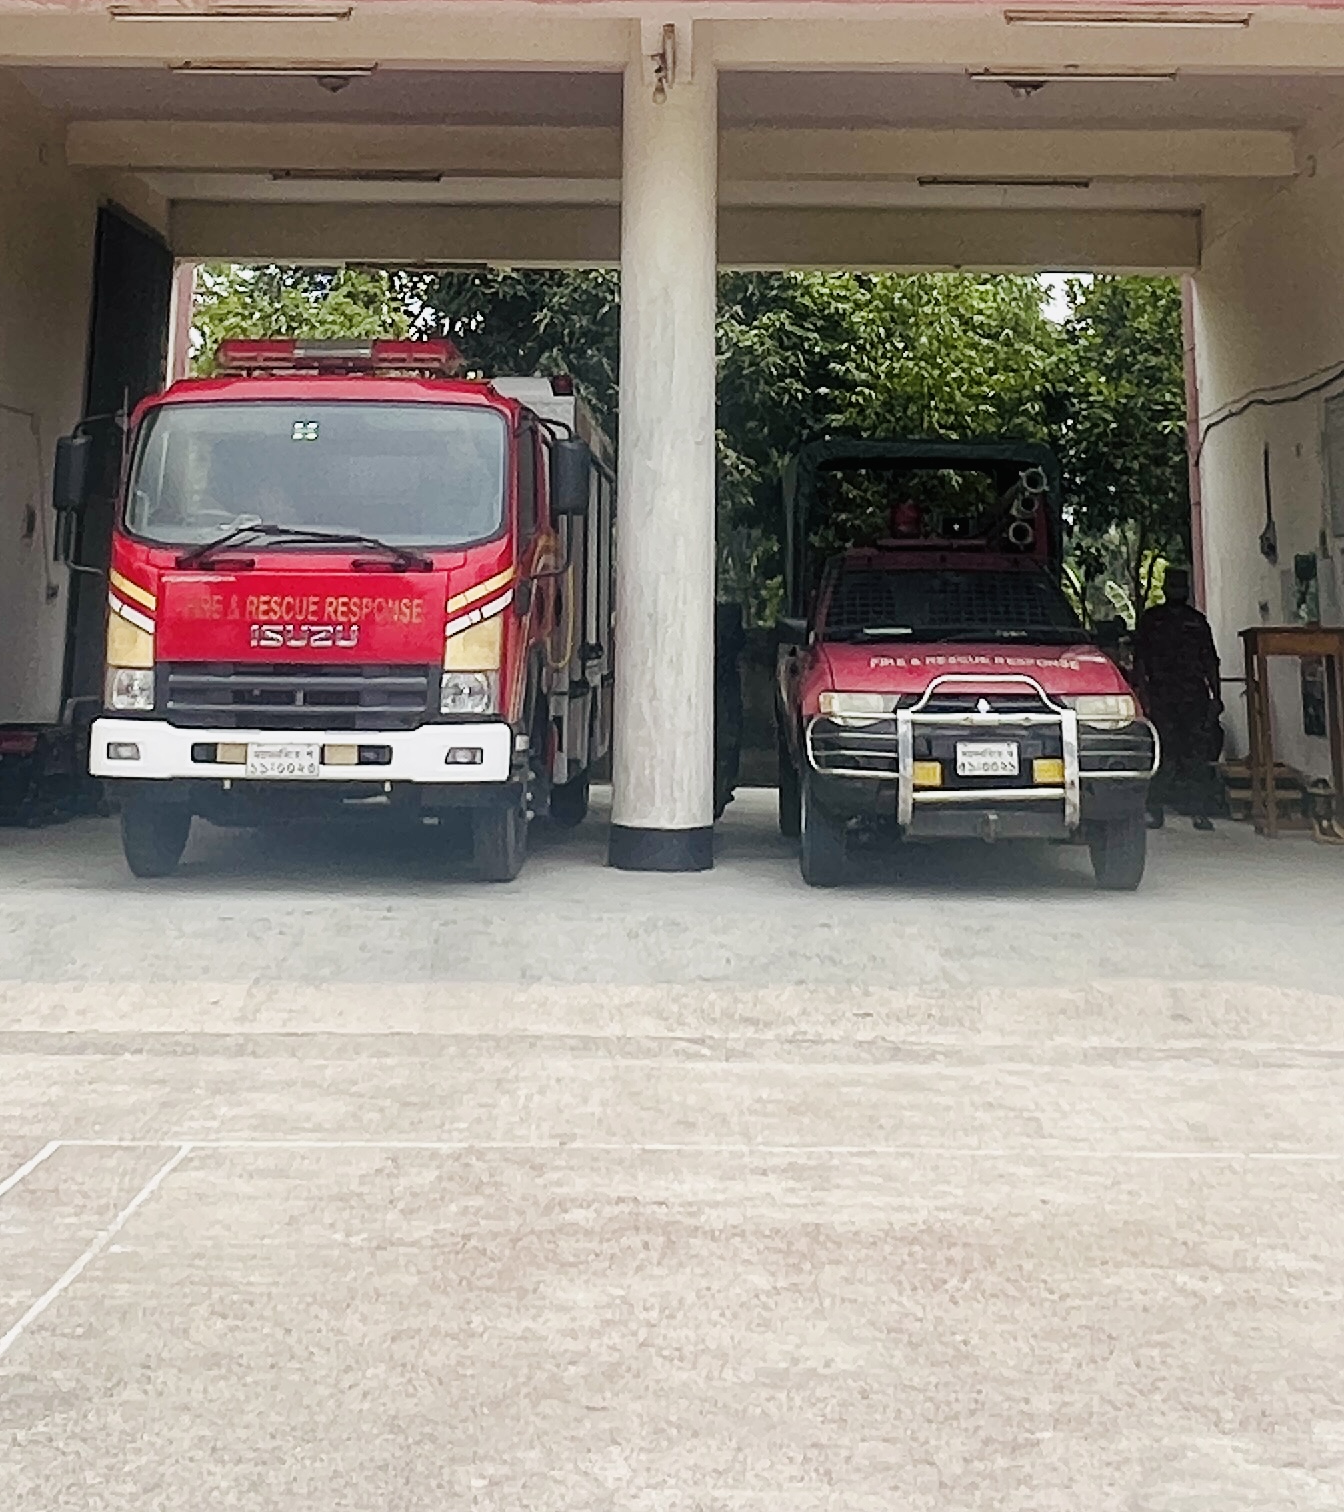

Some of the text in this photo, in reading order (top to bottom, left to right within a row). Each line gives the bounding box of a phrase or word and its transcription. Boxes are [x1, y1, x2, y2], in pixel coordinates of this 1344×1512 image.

[246, 595, 320, 621] RESCUE
[324, 596, 424, 625] RESPONSE
[250, 623, 359, 648] ISUZU
